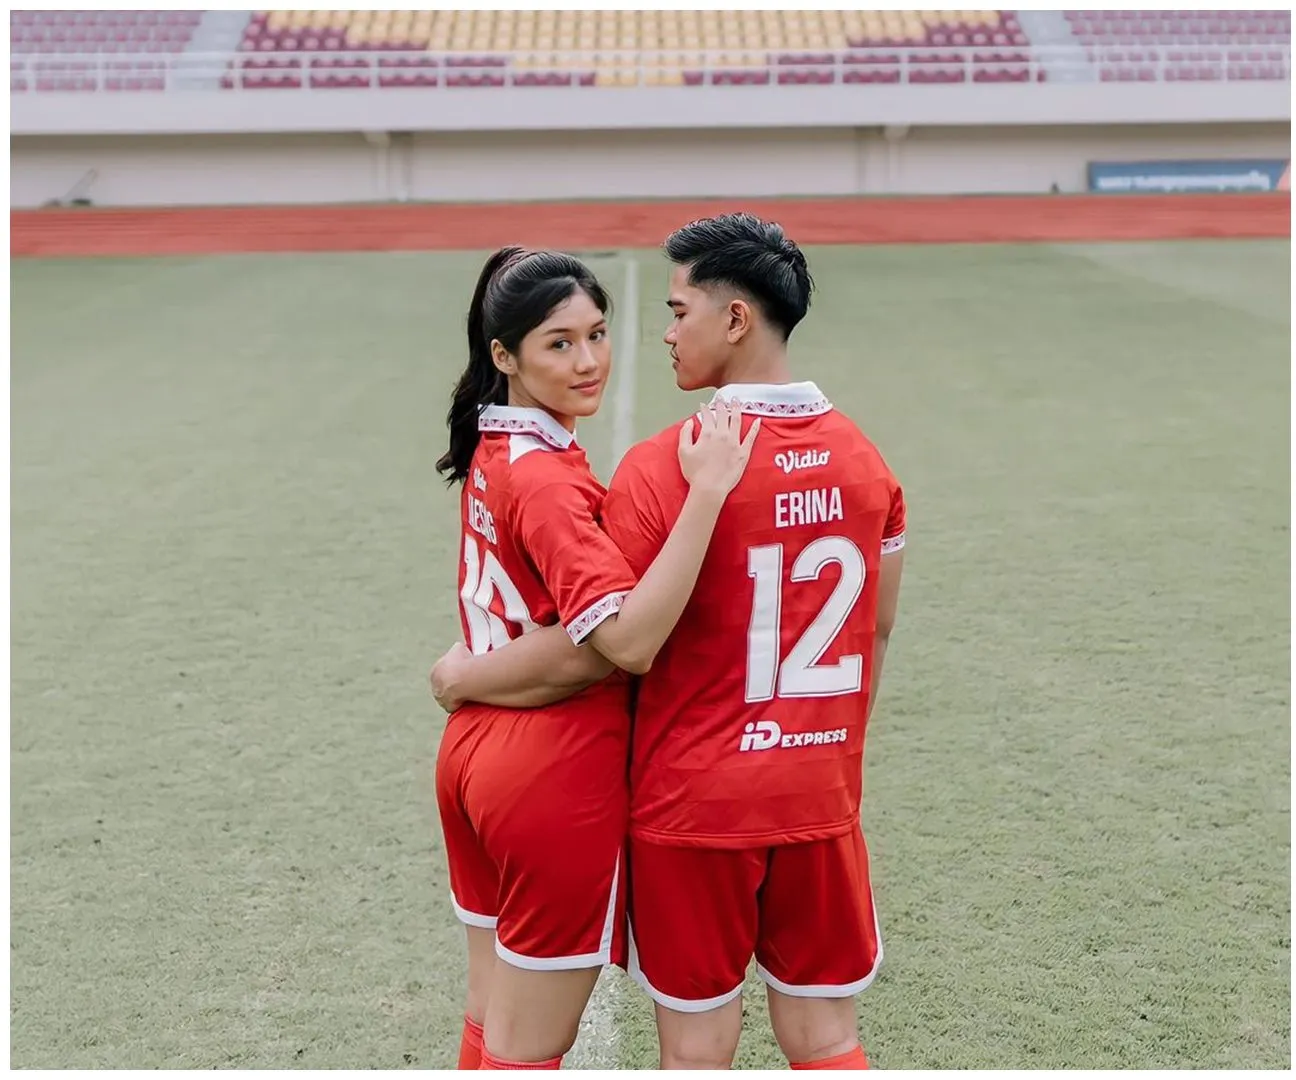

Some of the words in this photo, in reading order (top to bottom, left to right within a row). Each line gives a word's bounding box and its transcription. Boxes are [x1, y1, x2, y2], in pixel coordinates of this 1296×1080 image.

[774, 449, 831, 474] Vidio
[775, 486, 844, 529] ERINA
[744, 535, 867, 703] 12
[781, 728, 848, 748] EXPRESS
